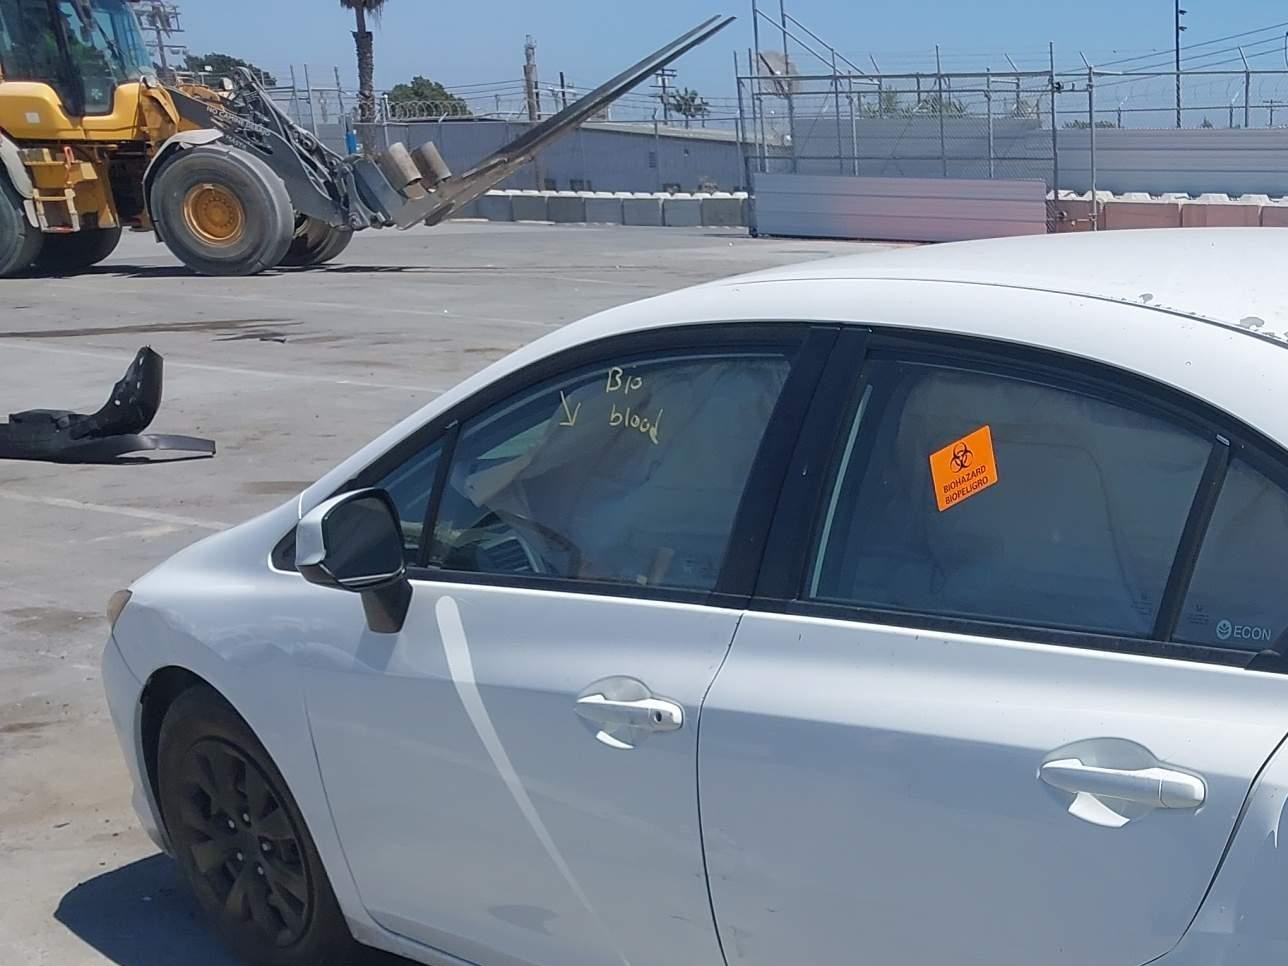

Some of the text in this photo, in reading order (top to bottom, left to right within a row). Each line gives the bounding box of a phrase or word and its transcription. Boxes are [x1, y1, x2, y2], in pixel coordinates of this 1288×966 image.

[609, 404, 663, 444] blood
[943, 465, 986, 493] BIOHAZARD
[945, 476, 989, 505] BIOPELIGRO
[1233, 625, 1272, 641] ECON
